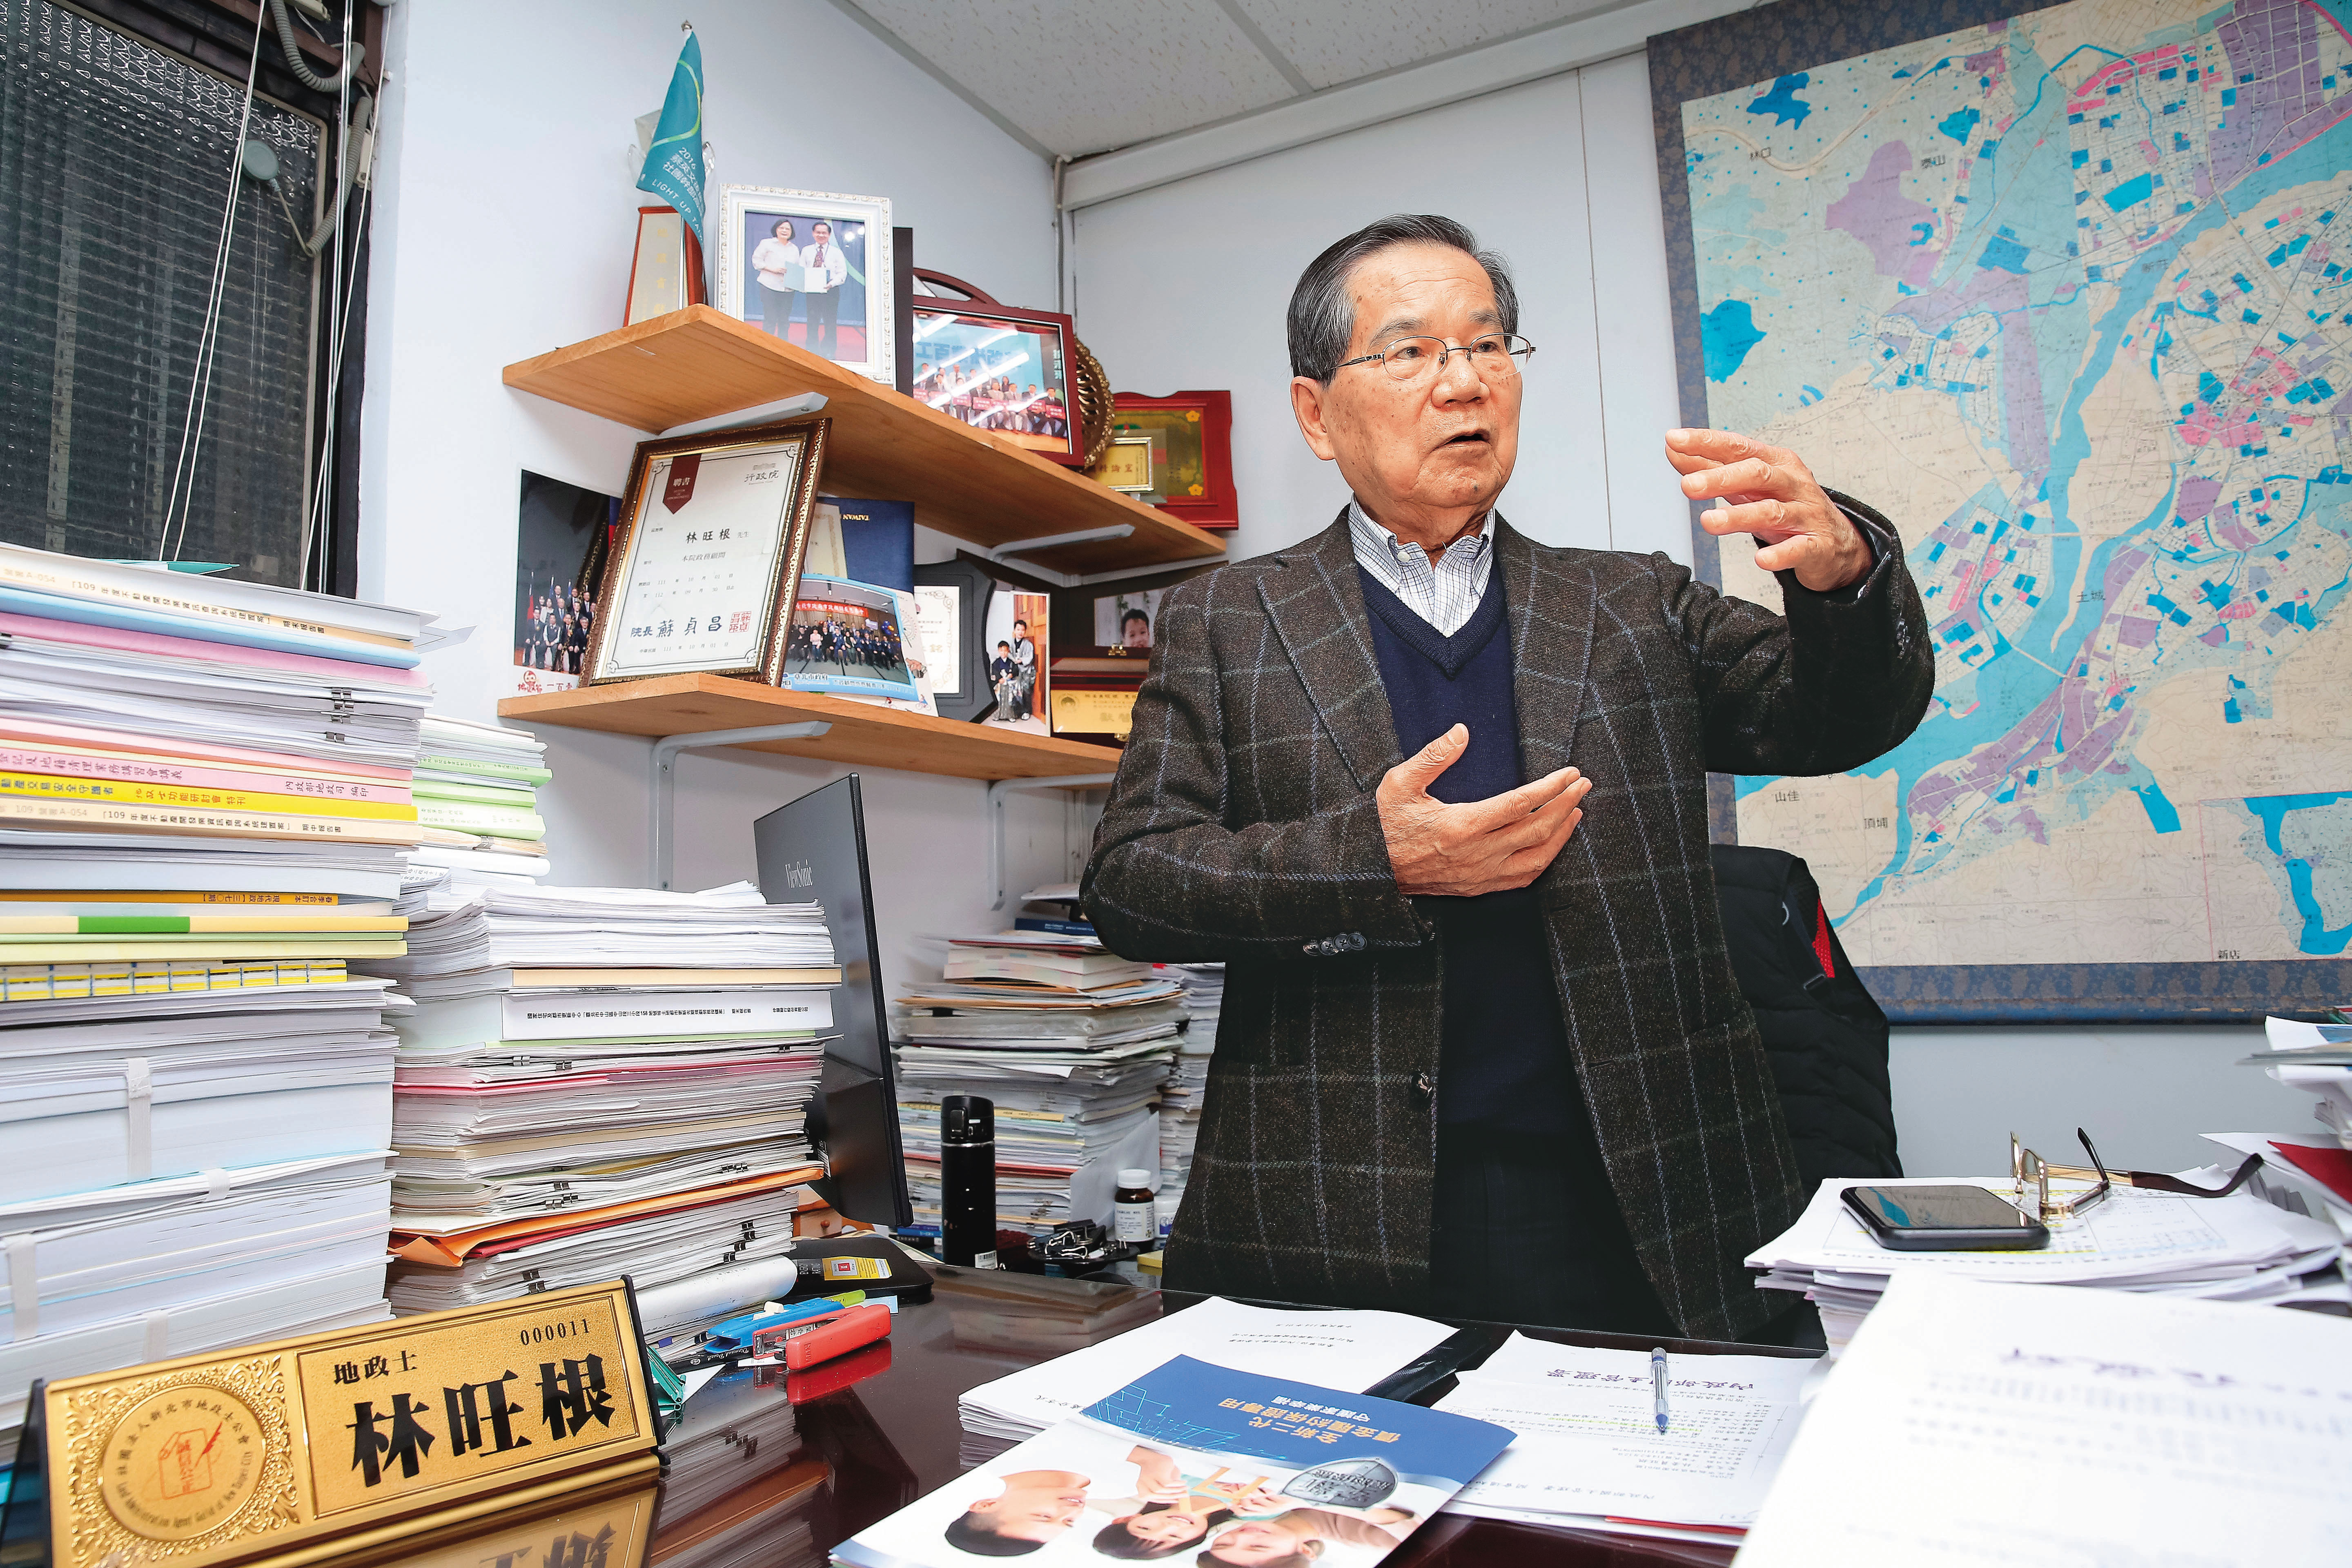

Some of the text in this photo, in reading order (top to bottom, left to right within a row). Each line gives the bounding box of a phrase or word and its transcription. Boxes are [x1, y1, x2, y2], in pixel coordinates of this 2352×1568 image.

[678, 147, 697, 170] 2016
[652, 178, 679, 199] LIGHT
[679, 200, 691, 213] UP
[744, 470, 779, 483] 行政院
[686, 528, 731, 544] 林旺根
[2076, 590, 2105, 603] 土城
[283, 620, 325, 634] 期末報告書
[630, 615, 722, 638] 院長 蘇貞昌
[136, 788, 221, 804] 地政士功能研討會
[226, 795, 245, 805] 特刊
[285, 780, 345, 794] 內政部地政司
[350, 786, 369, 797] 編印
[1775, 790, 1800, 802] 山佳
[302, 823, 341, 833] 期中報告書
[785, 859, 813, 889] ViewSonic
[294, 895, 332, 903] 春季合訂本
[2218, 950, 2240, 960] 新店
[520, 1319, 590, 1346] 000011
[706, 1347, 749, 1361] Diamond Pencil
[333, 1350, 418, 1385] 地政士
[1270, 1395, 1371, 1422] 守護家業幸福
[346, 1353, 615, 1488] 林旺根
[1218, 1397, 1401, 1443] 價金履約保證專用
[1248, 1417, 1343, 1444] 全新二代
